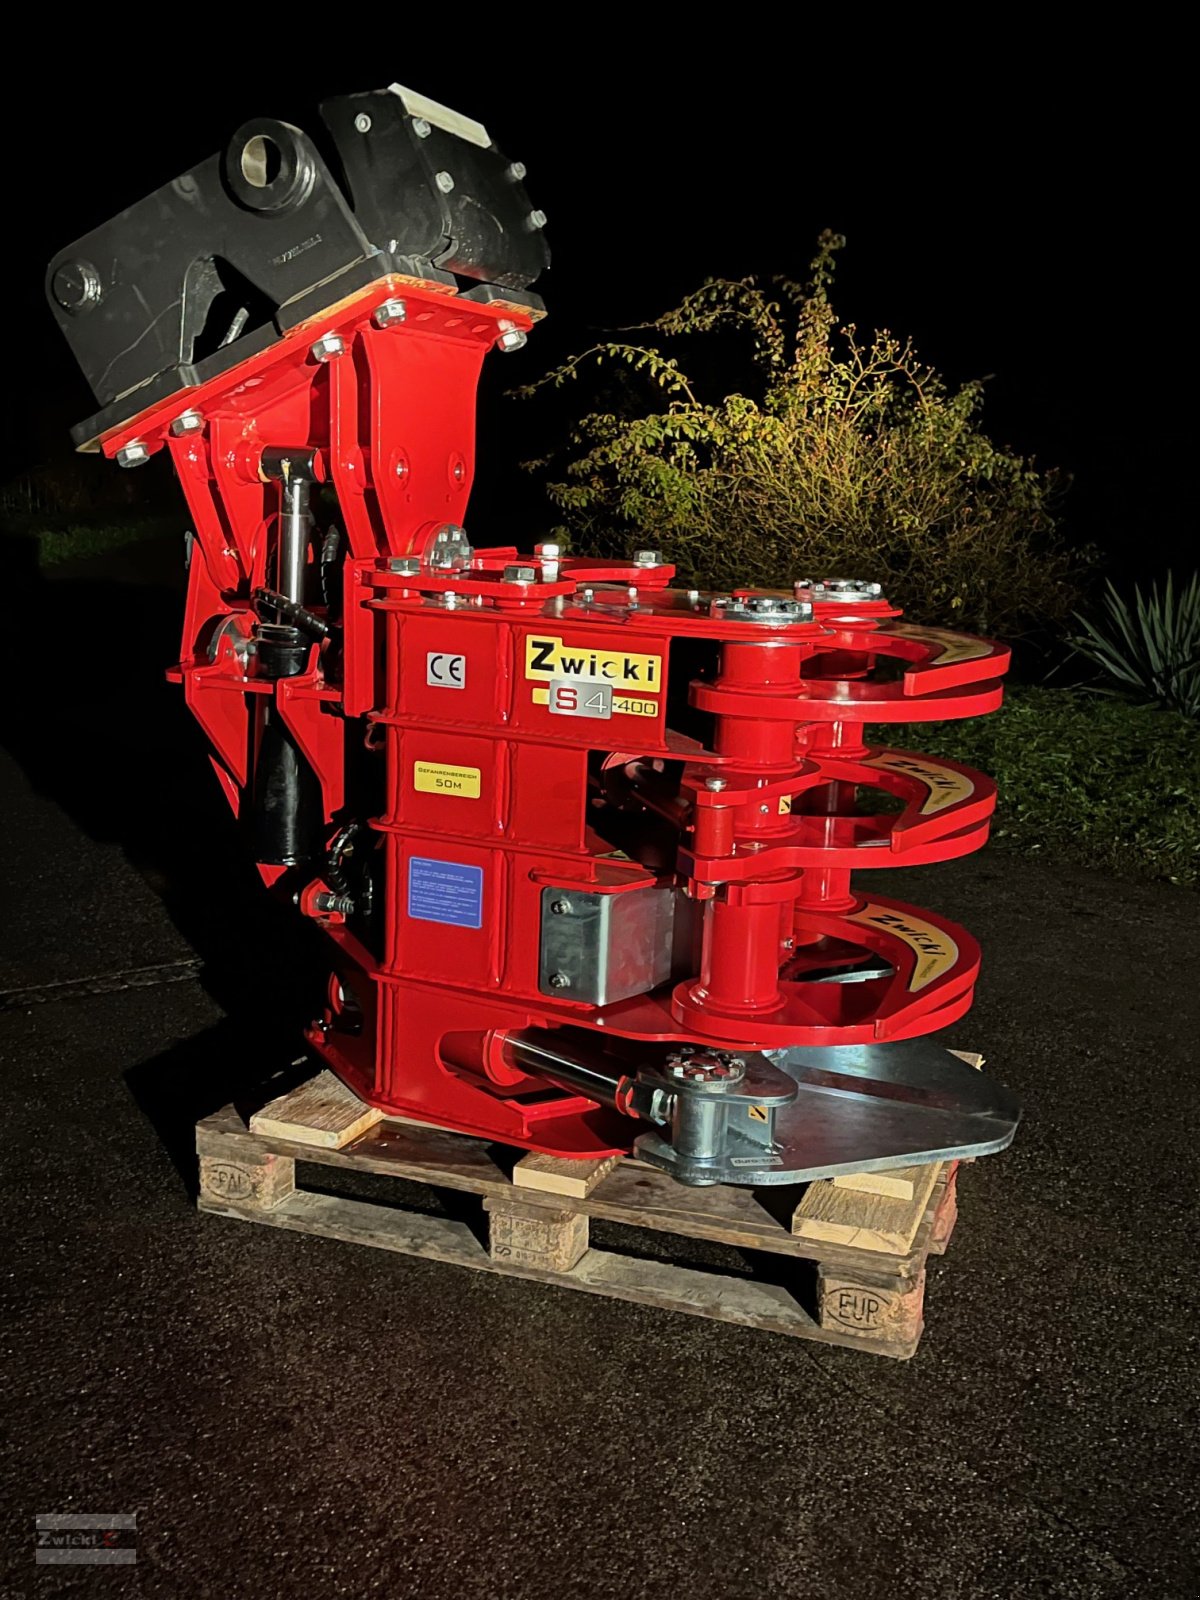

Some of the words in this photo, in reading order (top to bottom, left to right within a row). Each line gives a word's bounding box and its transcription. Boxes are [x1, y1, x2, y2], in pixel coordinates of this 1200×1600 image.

[431, 655, 461, 681] CE
[531, 640, 655, 682] Zwicki
[839, 1293, 879, 1325] EUR
